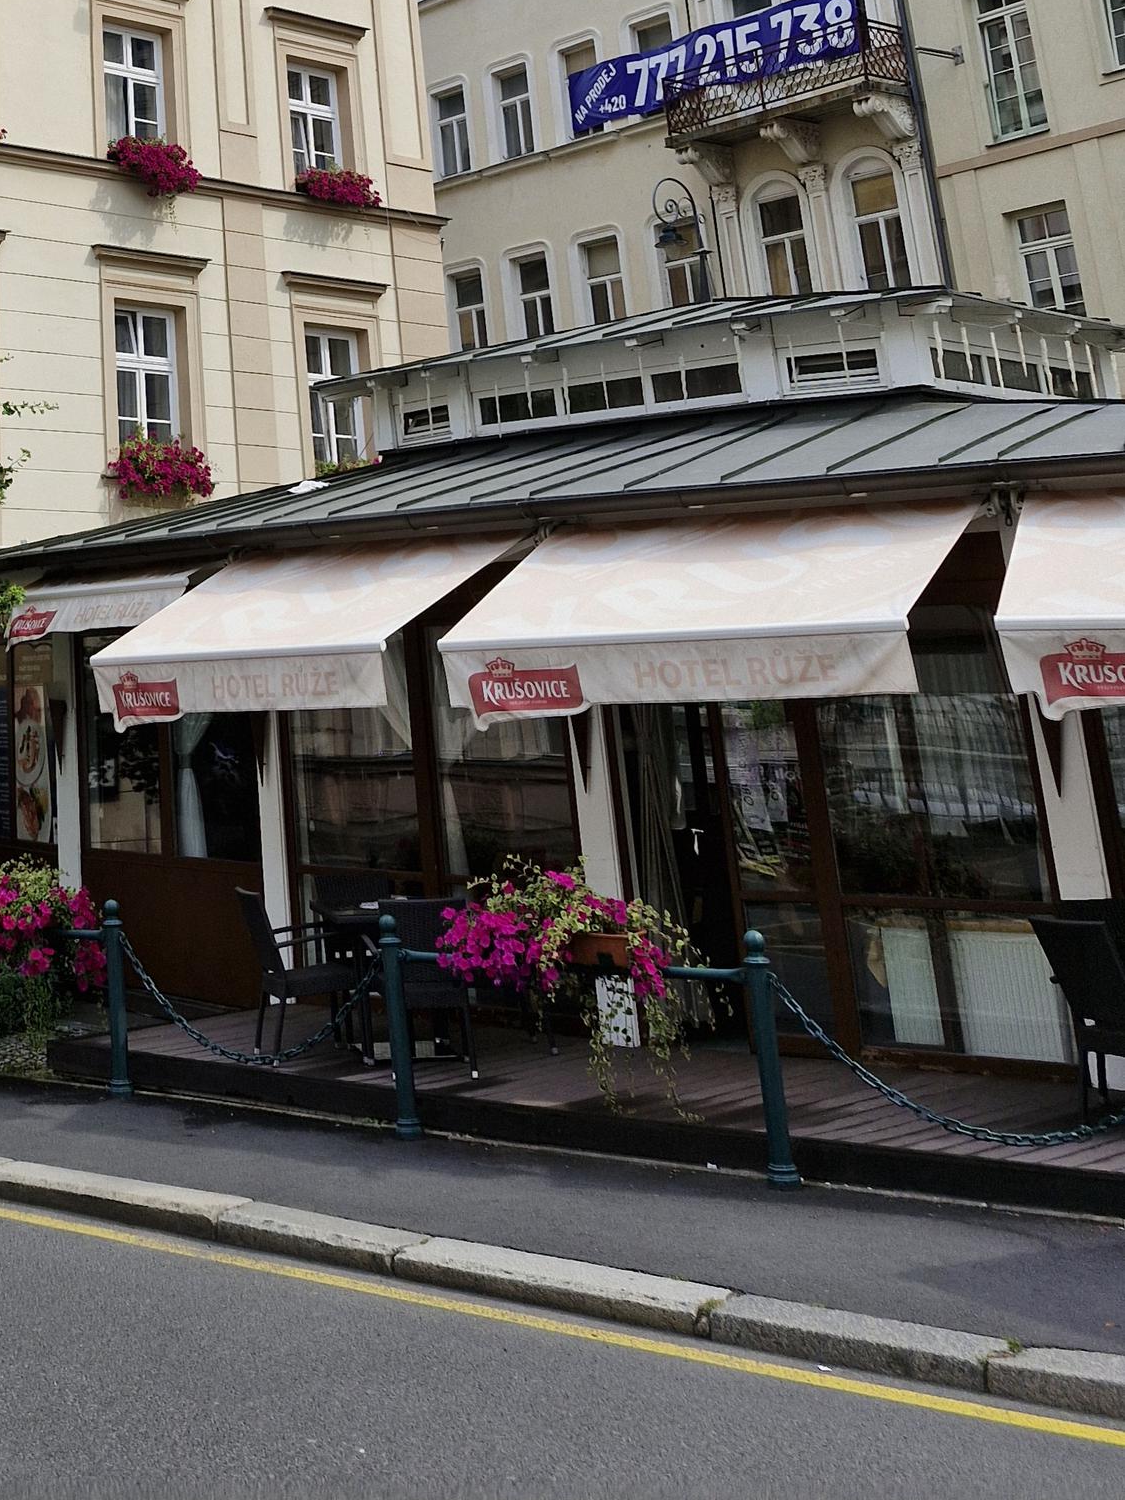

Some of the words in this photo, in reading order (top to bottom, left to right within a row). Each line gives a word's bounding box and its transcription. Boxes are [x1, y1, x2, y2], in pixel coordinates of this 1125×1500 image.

[626, 44, 687, 107] 777
[694, 21, 763, 86] 215
[574, 104, 589, 125] NA
[585, 62, 617, 109] PRODEJ
[598, 94, 626, 113] +420
[74, 604, 112, 624] HOTEL
[634, 658, 742, 690] HOTEL
[746, 648, 839, 686] RŮŽE
[118, 688, 172, 710] KRUŠOVICE
[211, 674, 276, 700] HOTEL
[481, 676, 571, 707] KRUŠOVICE
